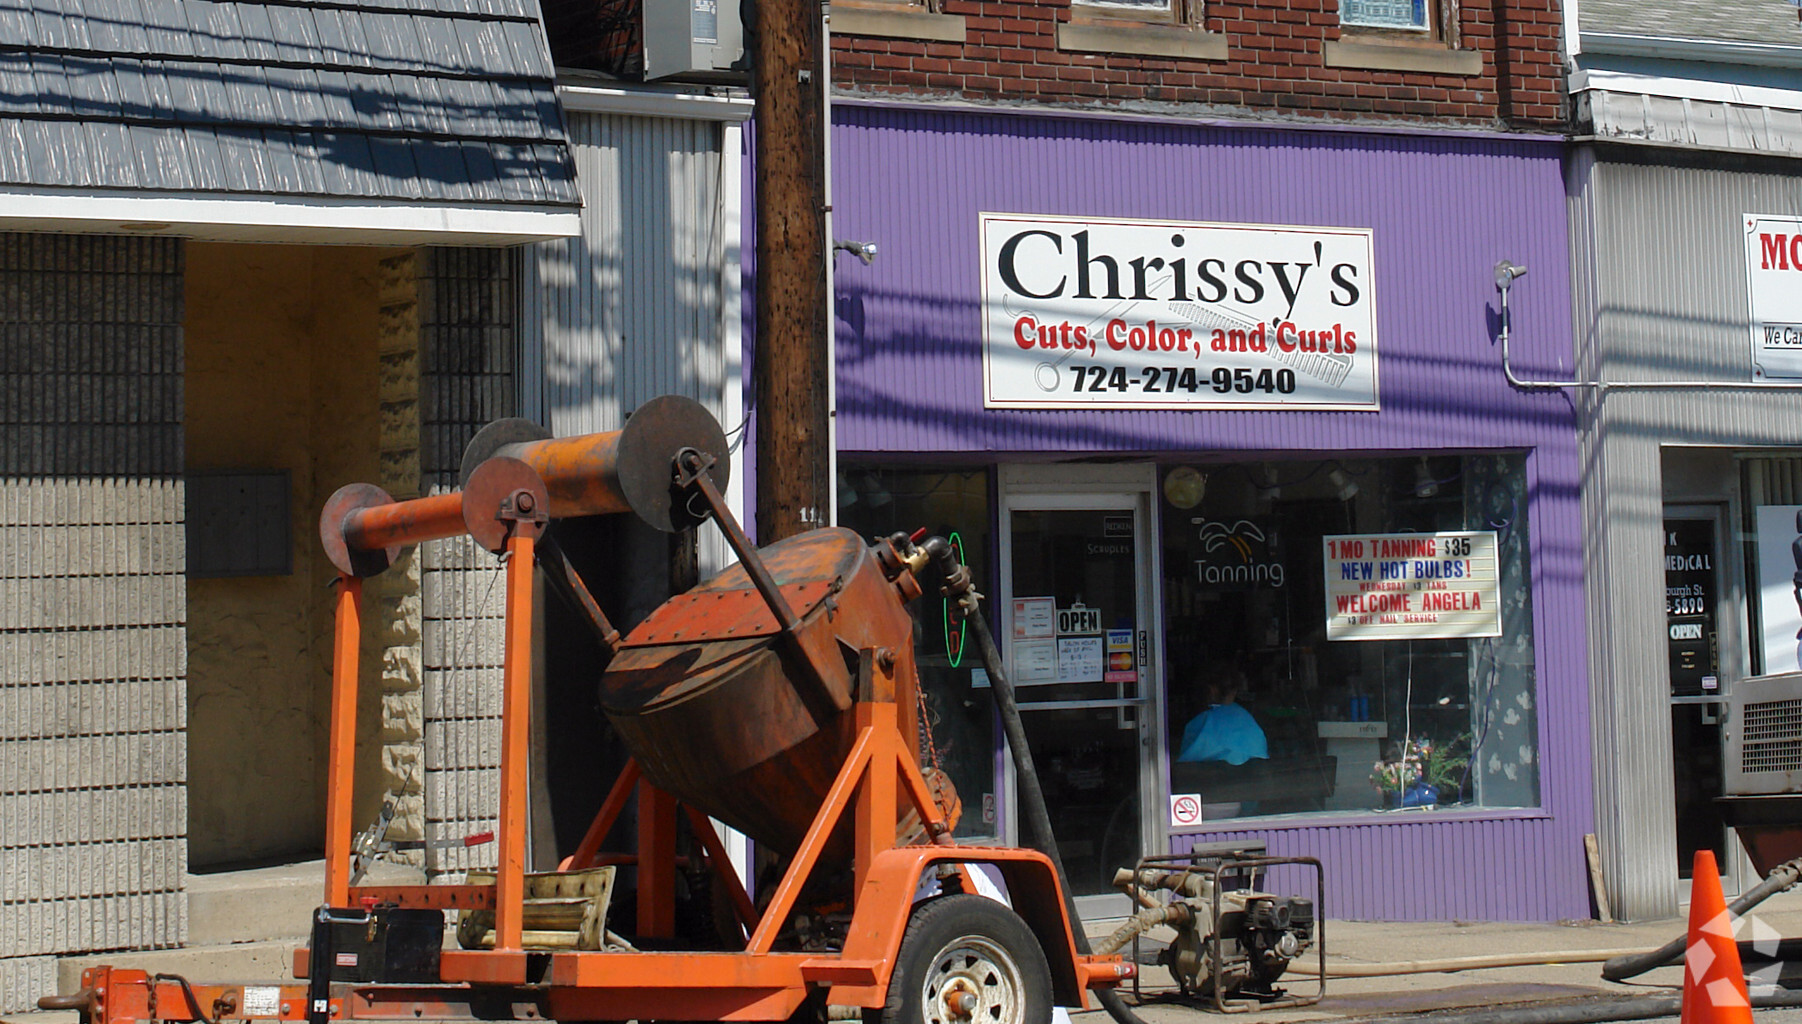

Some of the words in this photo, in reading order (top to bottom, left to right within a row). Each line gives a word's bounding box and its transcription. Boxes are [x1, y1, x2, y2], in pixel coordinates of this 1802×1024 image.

[998, 229, 1360, 328] Chrissy's
[1014, 316, 1096, 357] Cuts,
[1106, 319, 1200, 359] Color,
[1211, 323, 1267, 353] and
[1277, 322, 1356, 355] Curls
[1764, 326, 1780, 344] We
[1069, 366, 1296, 394] 724-274-9540
[1340, 540, 1363, 559] MO
[1370, 539, 1436, 559] TANNING
[1445, 538, 1471, 556] $35
[1194, 558, 1284, 587] Tanning
[1341, 562, 1373, 580] NEW
[1380, 561, 1408, 579] HOT
[1415, 560, 1471, 579] BULBS!
[1359, 581, 1406, 592] WEDNESDAY
[1336, 593, 1411, 613] WELCOME
[1422, 592, 1481, 612] ANGELA
[1060, 611, 1097, 632] OPEN
[1359, 616, 1373, 625] OFF
[1112, 636, 1128, 644] VISA
[1670, 624, 1702, 640] OPEN
